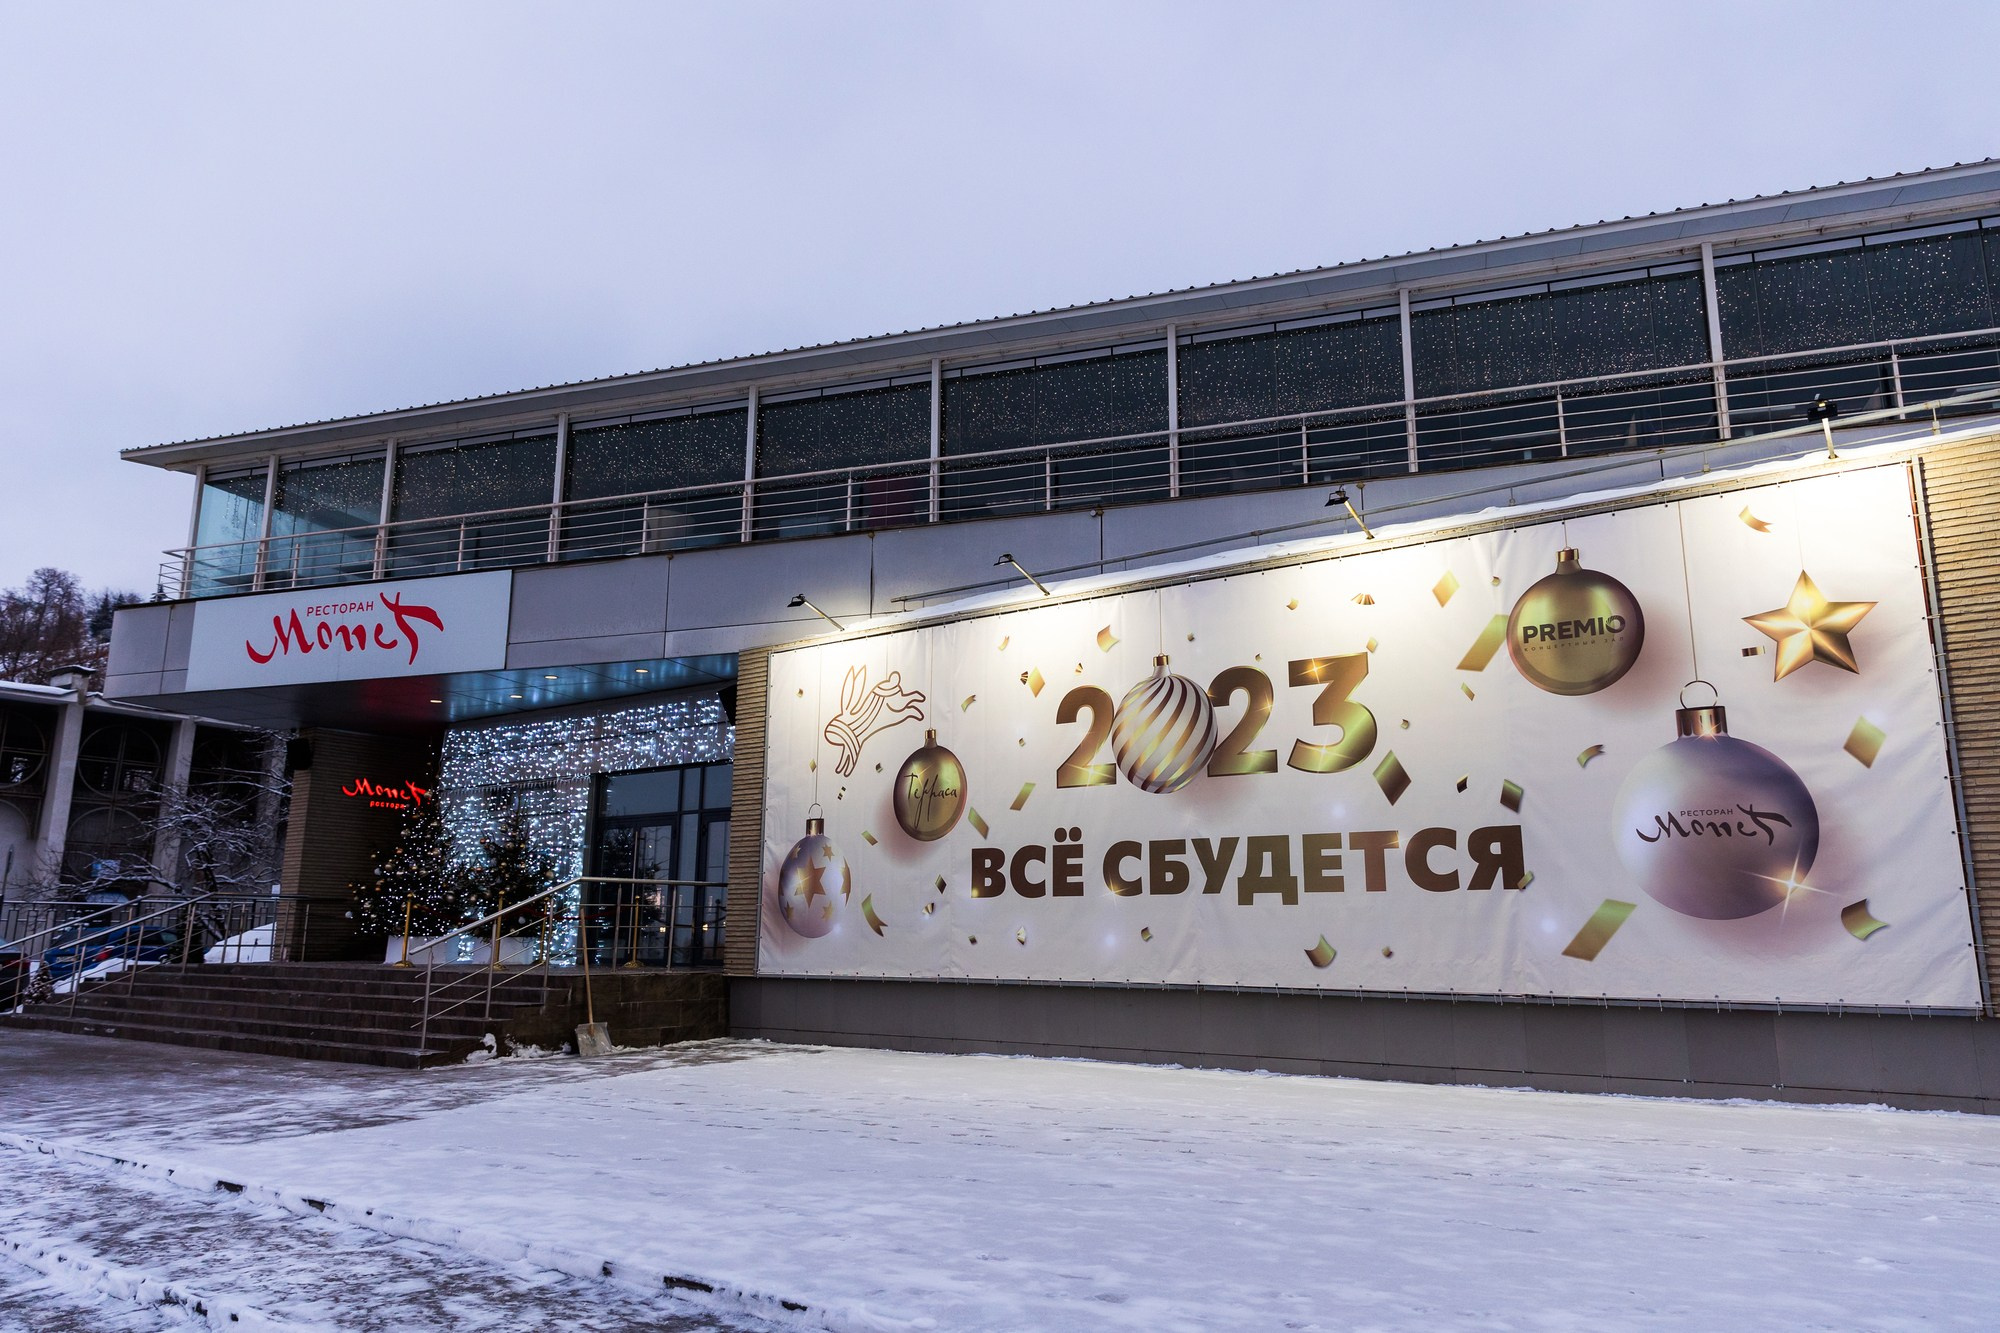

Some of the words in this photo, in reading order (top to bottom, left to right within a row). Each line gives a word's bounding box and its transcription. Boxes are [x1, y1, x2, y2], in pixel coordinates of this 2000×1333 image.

[306, 601, 374, 617] РЕСТОРАН
[246, 592, 444, 665] Monet
[1522, 615, 1626, 644] PREMIO
[1524, 640, 1596, 652] КОНЦЕРТНЫЙ
[1604, 636, 1624, 644] ЗАЛ
[370, 800, 405, 810] рестора
[904, 772, 957, 830] Терраса
[1680, 808, 1733, 817] РЕСТОРАН
[1636, 804, 1792, 846] Monet
[971, 826, 1084, 899] ВСЁ
[1102, 824, 1526, 906] СБУДЕТСЯ
